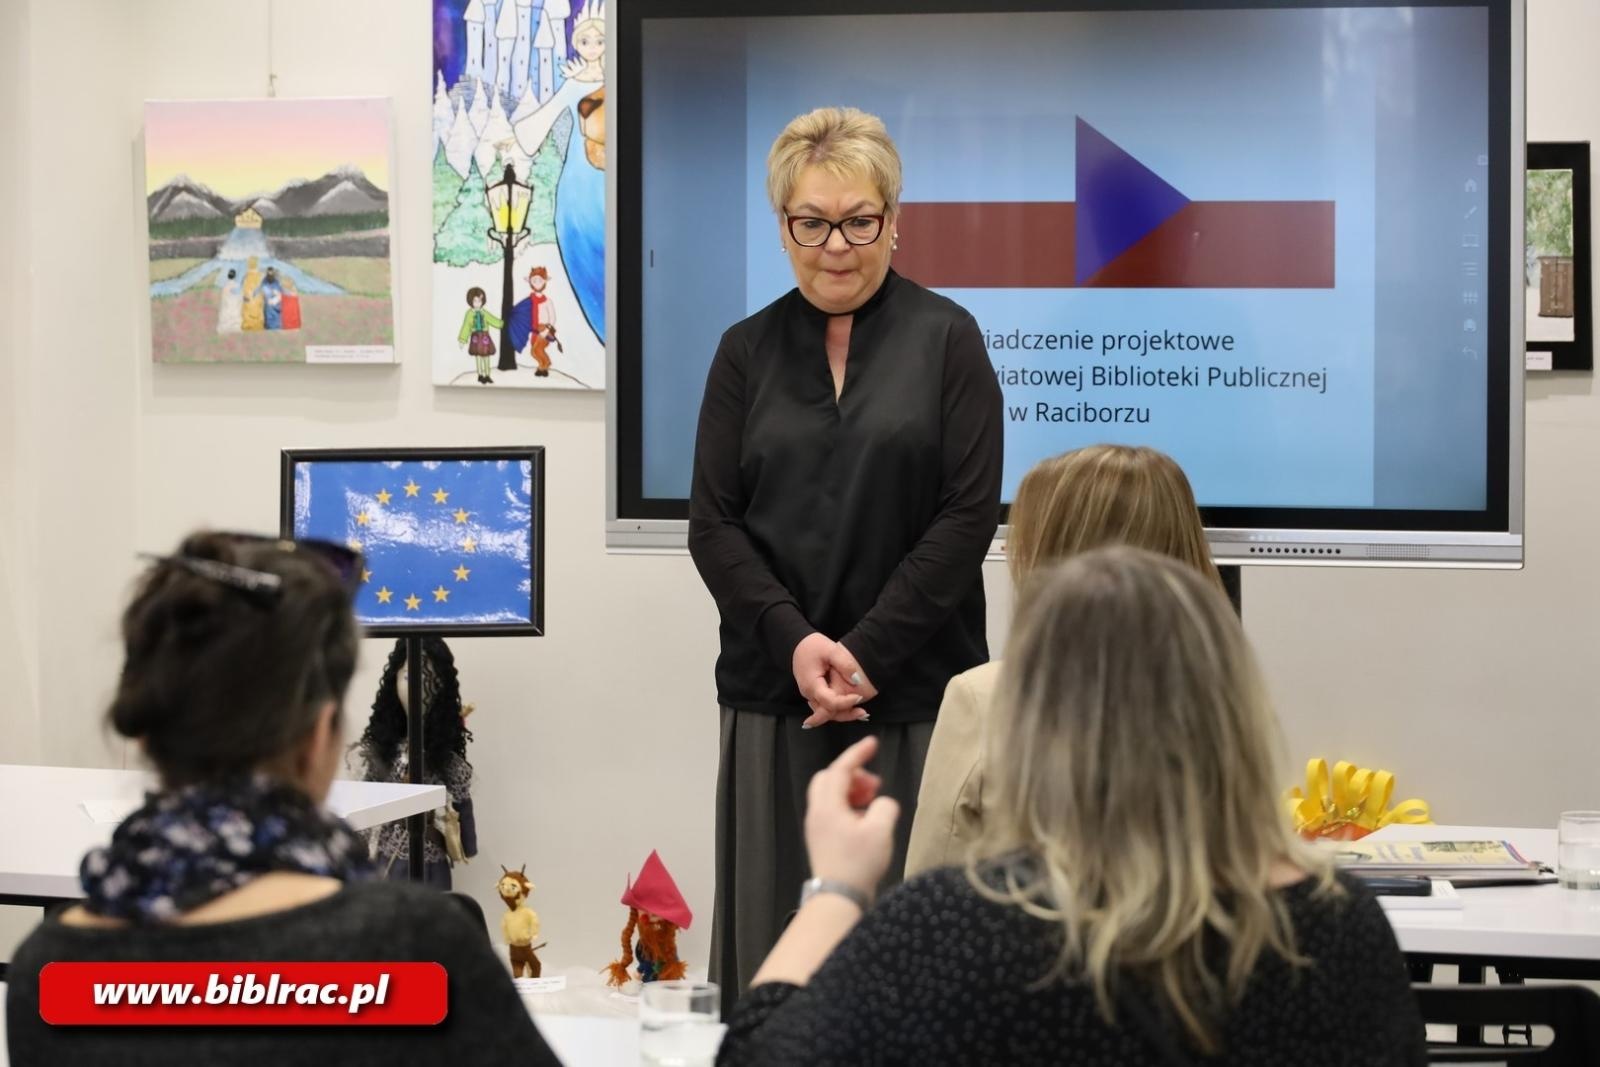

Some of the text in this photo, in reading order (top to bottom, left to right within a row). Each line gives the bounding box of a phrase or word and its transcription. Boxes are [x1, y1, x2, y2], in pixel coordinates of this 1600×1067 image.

[982, 328, 1235, 356] iadczenie projektowe
[996, 364, 1327, 394] iatowej Biblioteki Publicznej
[1009, 400, 1150, 423] w Raciborzu
